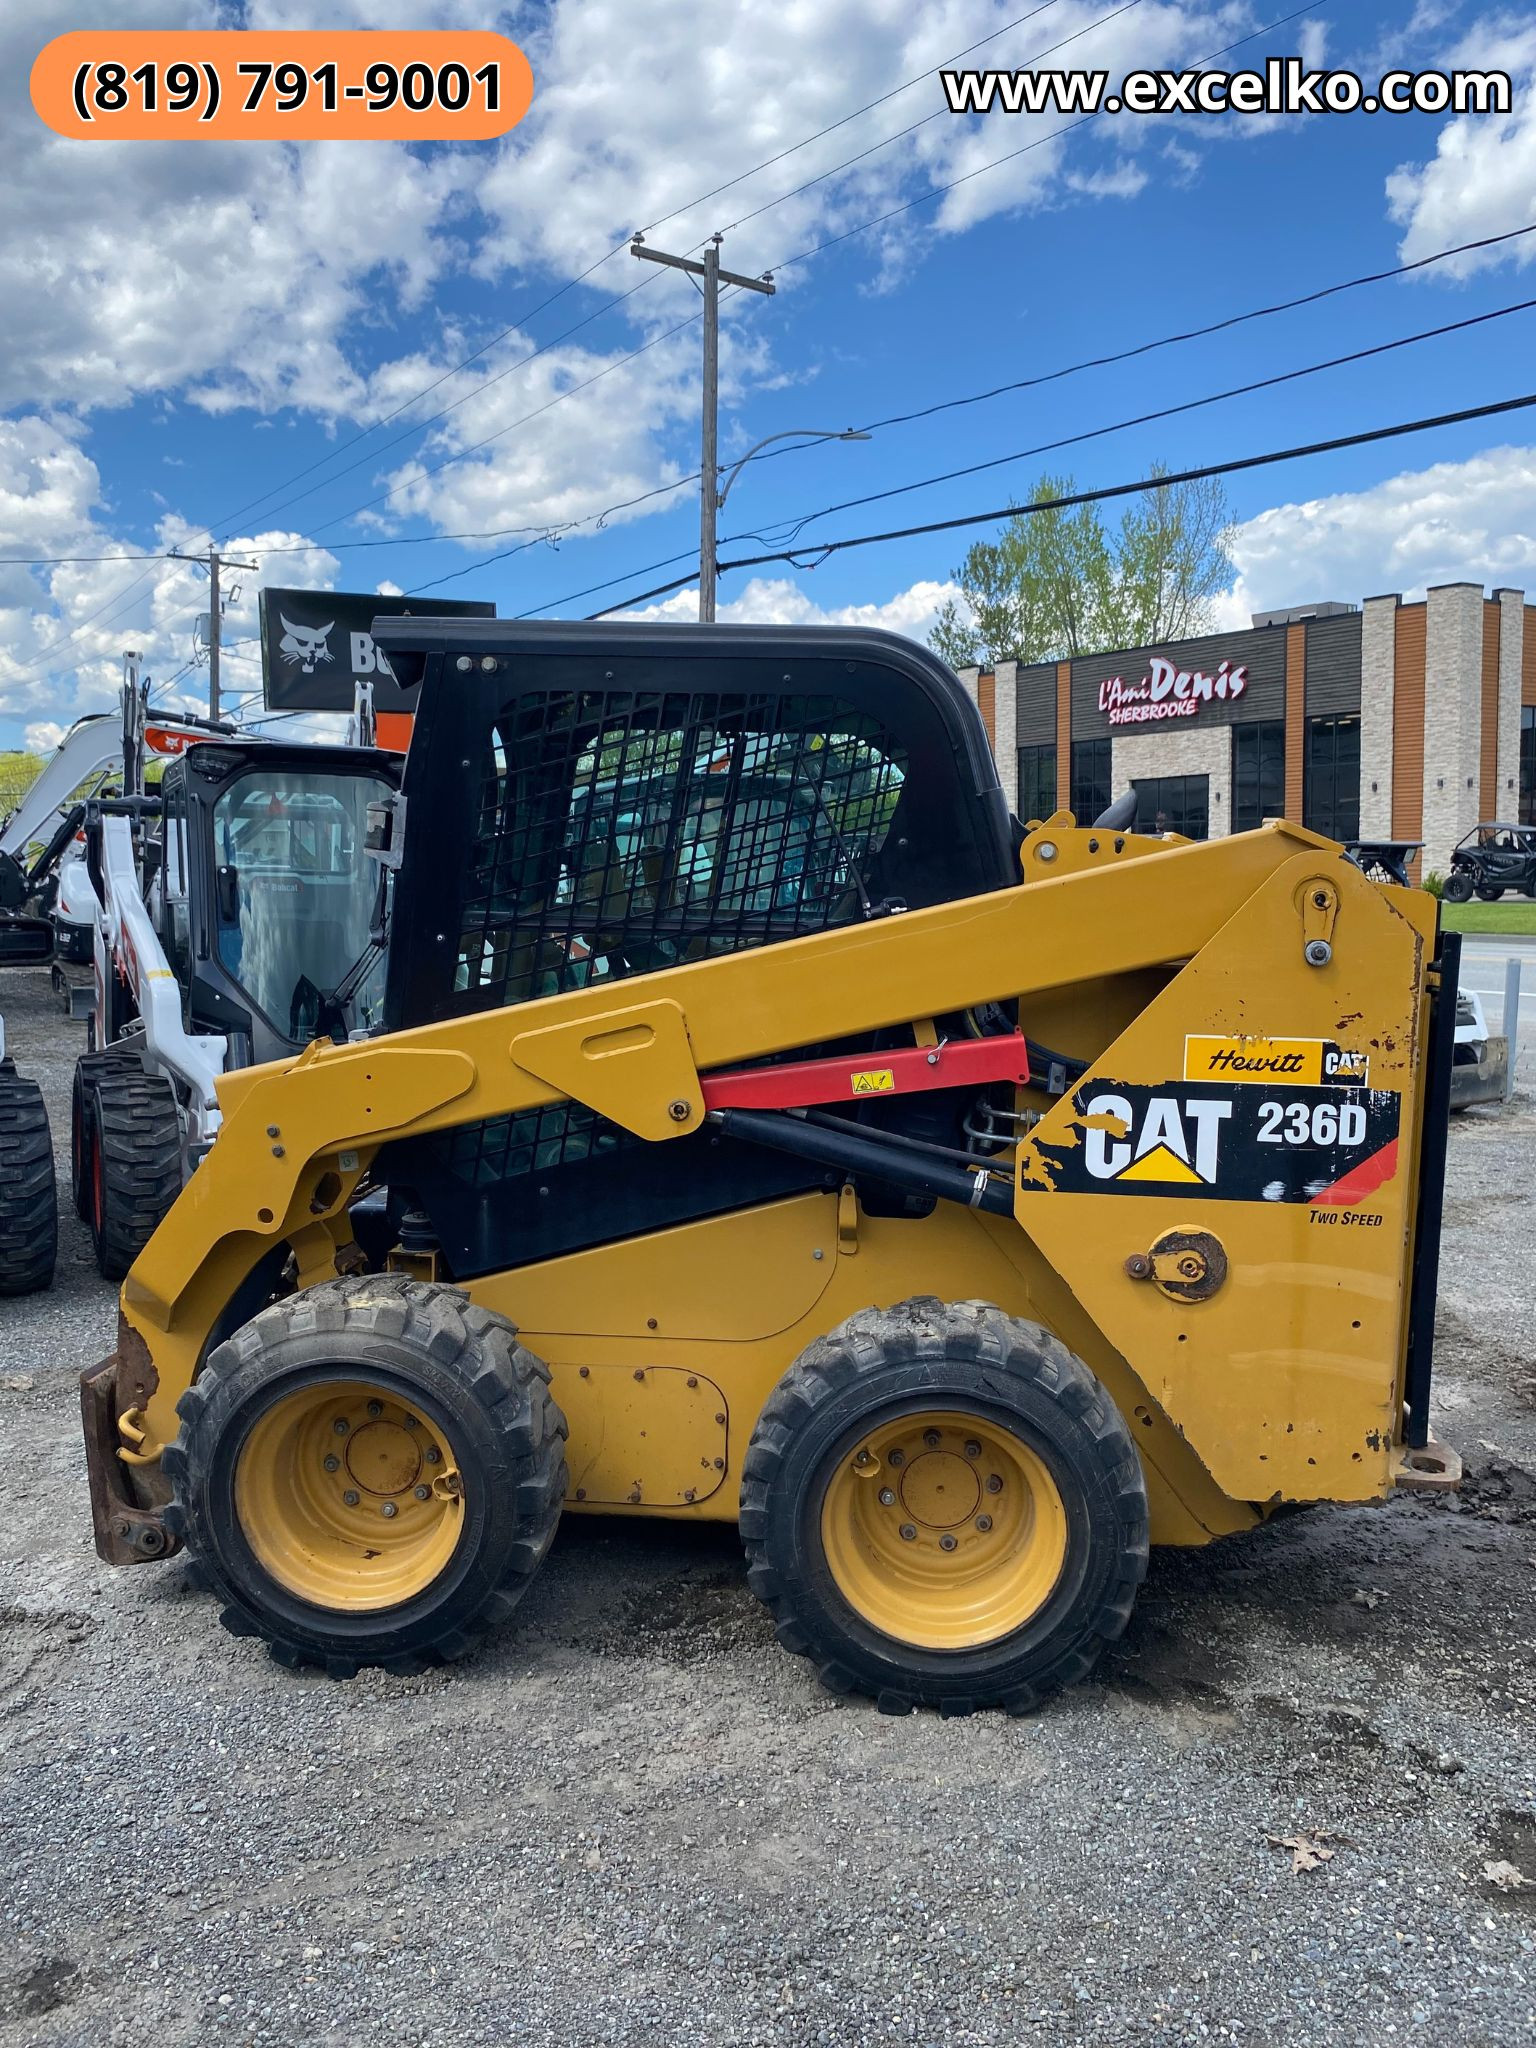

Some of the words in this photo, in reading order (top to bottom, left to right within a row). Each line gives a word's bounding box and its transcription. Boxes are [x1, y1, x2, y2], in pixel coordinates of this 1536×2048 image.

[1099, 677, 1151, 711] L'Ami
[1149, 656, 1248, 702] Denis
[1108, 699, 1199, 725] SHERBROOKE
[1209, 1049, 1306, 1073] Hewitt
[1325, 1052, 1363, 1076] CAT
[1085, 1094, 1233, 1184] CAT
[1256, 1102, 1367, 1146] 236D
